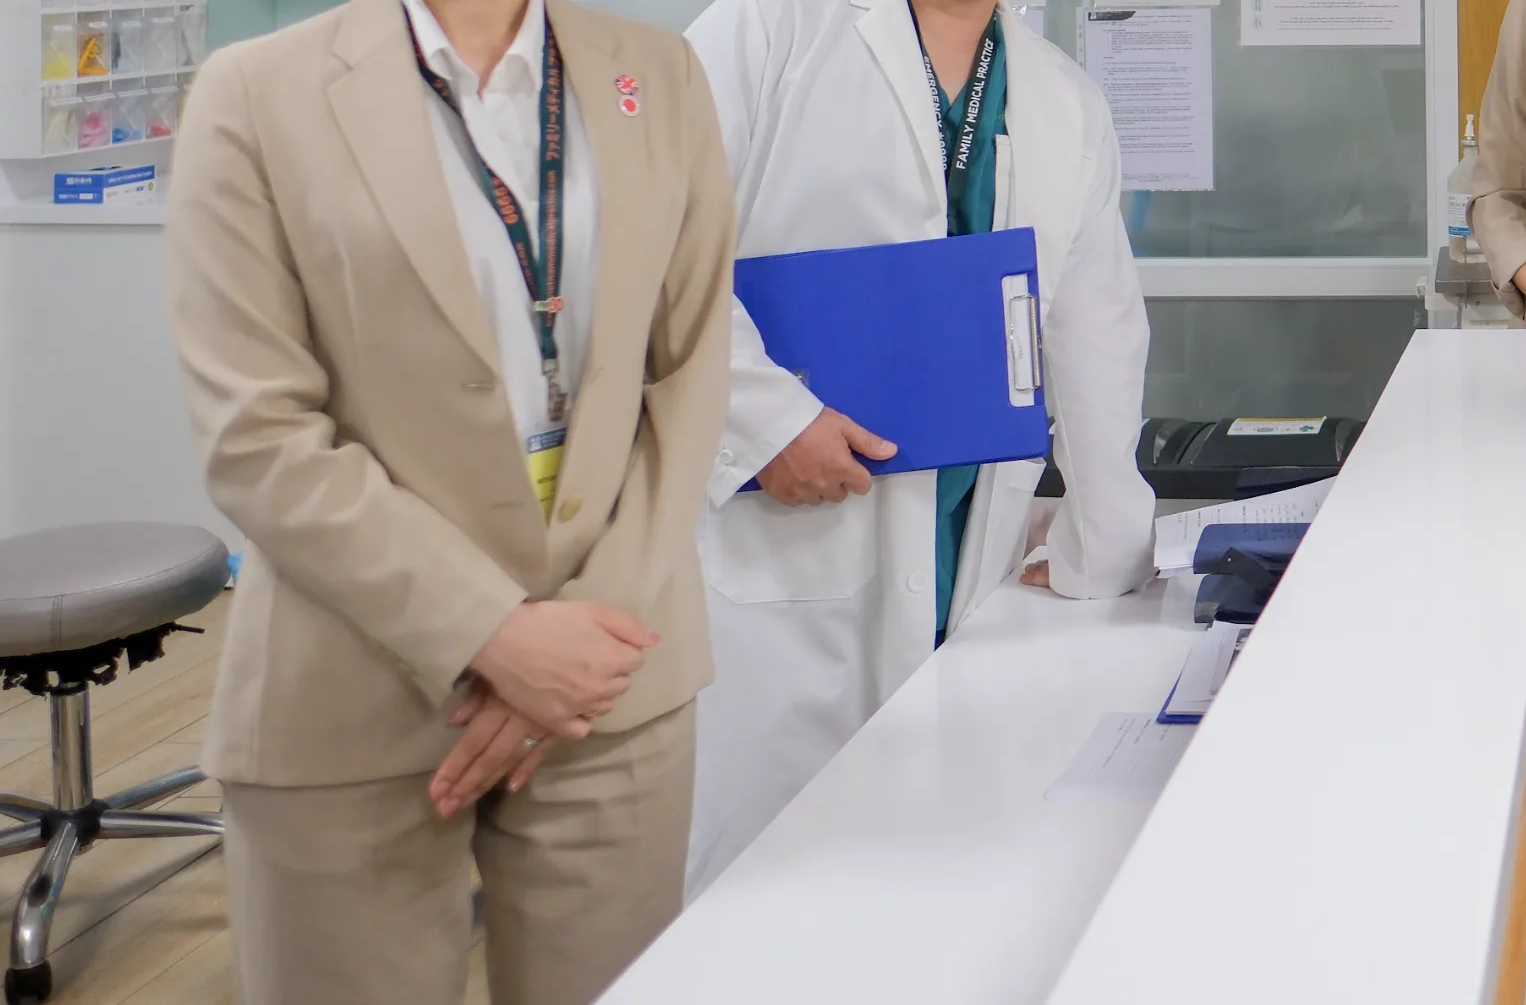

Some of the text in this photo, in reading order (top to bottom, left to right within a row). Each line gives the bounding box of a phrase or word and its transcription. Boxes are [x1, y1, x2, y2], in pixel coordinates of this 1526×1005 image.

[923, 55, 943, 128] EMERGENCY
[955, 38, 995, 170] FAMILY MEDICAL PRACTICE
